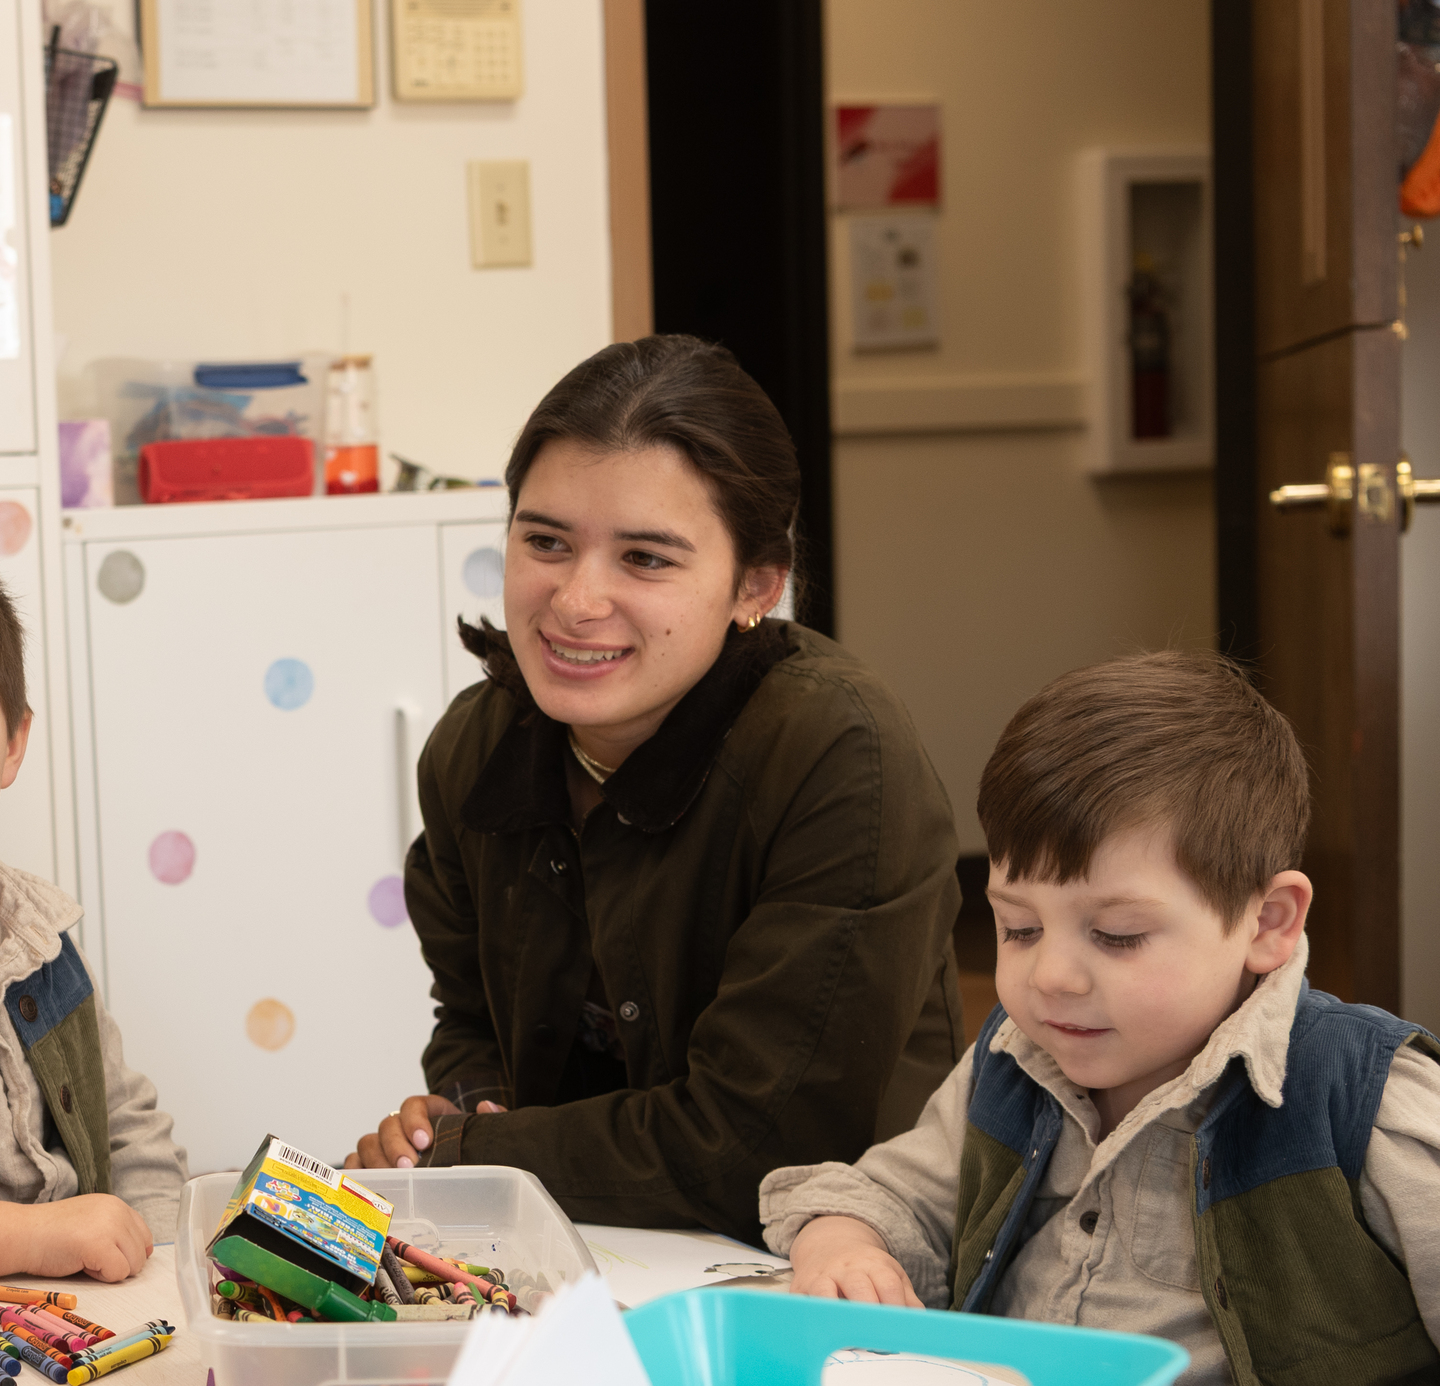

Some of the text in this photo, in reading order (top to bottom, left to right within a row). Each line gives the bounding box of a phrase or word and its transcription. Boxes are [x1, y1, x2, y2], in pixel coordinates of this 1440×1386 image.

[308, 1208, 331, 1222] TODAY
[336, 1218, 355, 1233] FREE
[64, 1312, 89, 1326] Crayola
[28, 1336, 49, 1351] Crayola
[23, 1347, 45, 1363] Crayola
